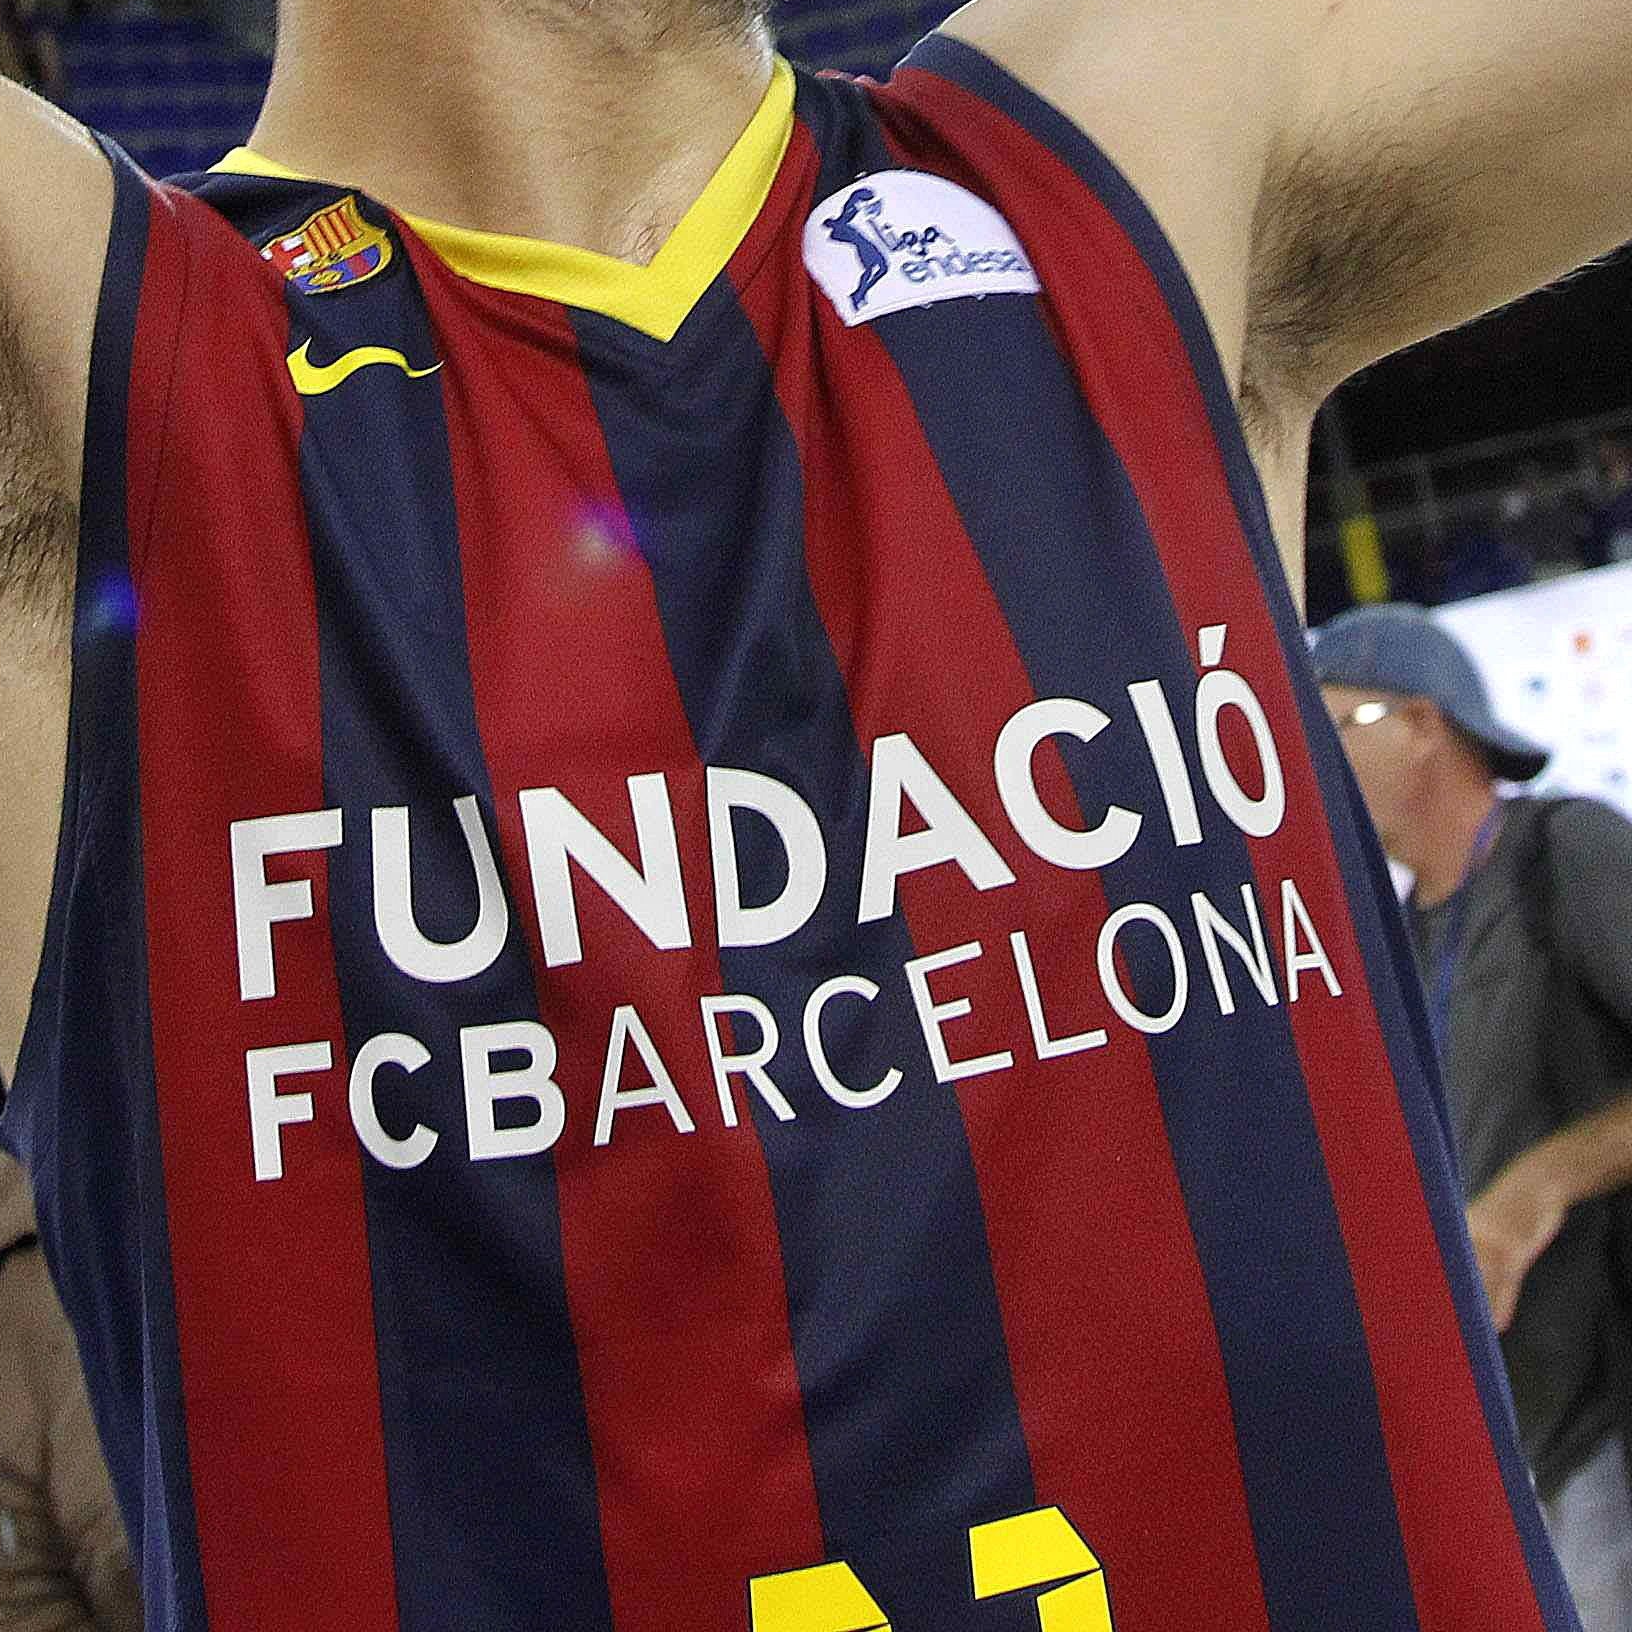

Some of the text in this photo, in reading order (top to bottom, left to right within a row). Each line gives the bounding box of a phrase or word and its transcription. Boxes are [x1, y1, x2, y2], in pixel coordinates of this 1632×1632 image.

[868, 218, 944, 257] liga
[899, 245, 1031, 283] endesa
[229, 623, 1287, 1001] FUNDACIÓ
